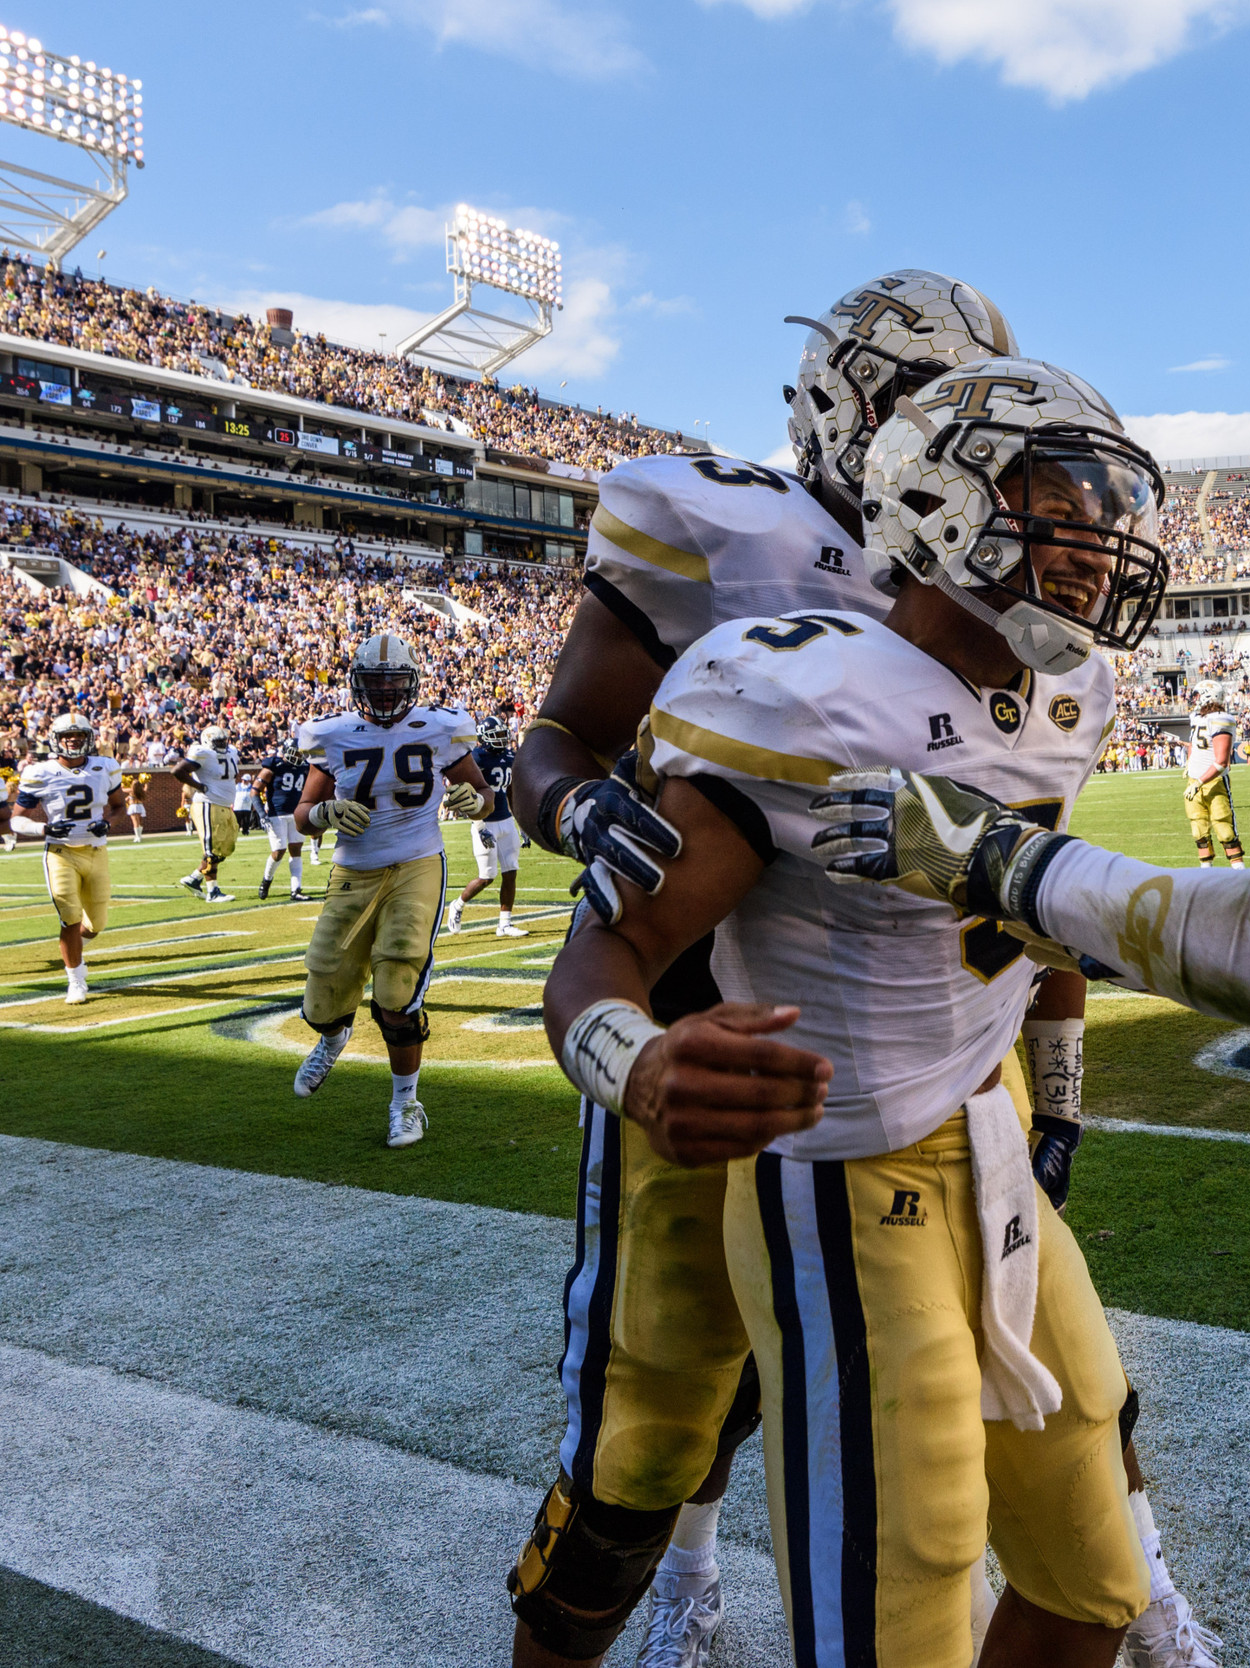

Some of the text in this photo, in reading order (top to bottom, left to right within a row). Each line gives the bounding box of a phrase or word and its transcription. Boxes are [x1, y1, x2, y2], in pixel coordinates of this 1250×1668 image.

[225, 421, 250, 437] 13:25
[267, 430, 272, 440] 4
[280, 432, 290, 442] 25
[813, 561, 853, 577] RUSSELL
[995, 702, 1018, 724] GT
[1056, 701, 1078, 717] ACC
[927, 735, 965, 752] RUSSELL
[281, 772, 305, 792] 94
[343, 743, 435, 810] 79
[490, 767, 512, 793] 30
[66, 784, 94, 820] 2
[879, 1216, 926, 1227] RUSSELL
